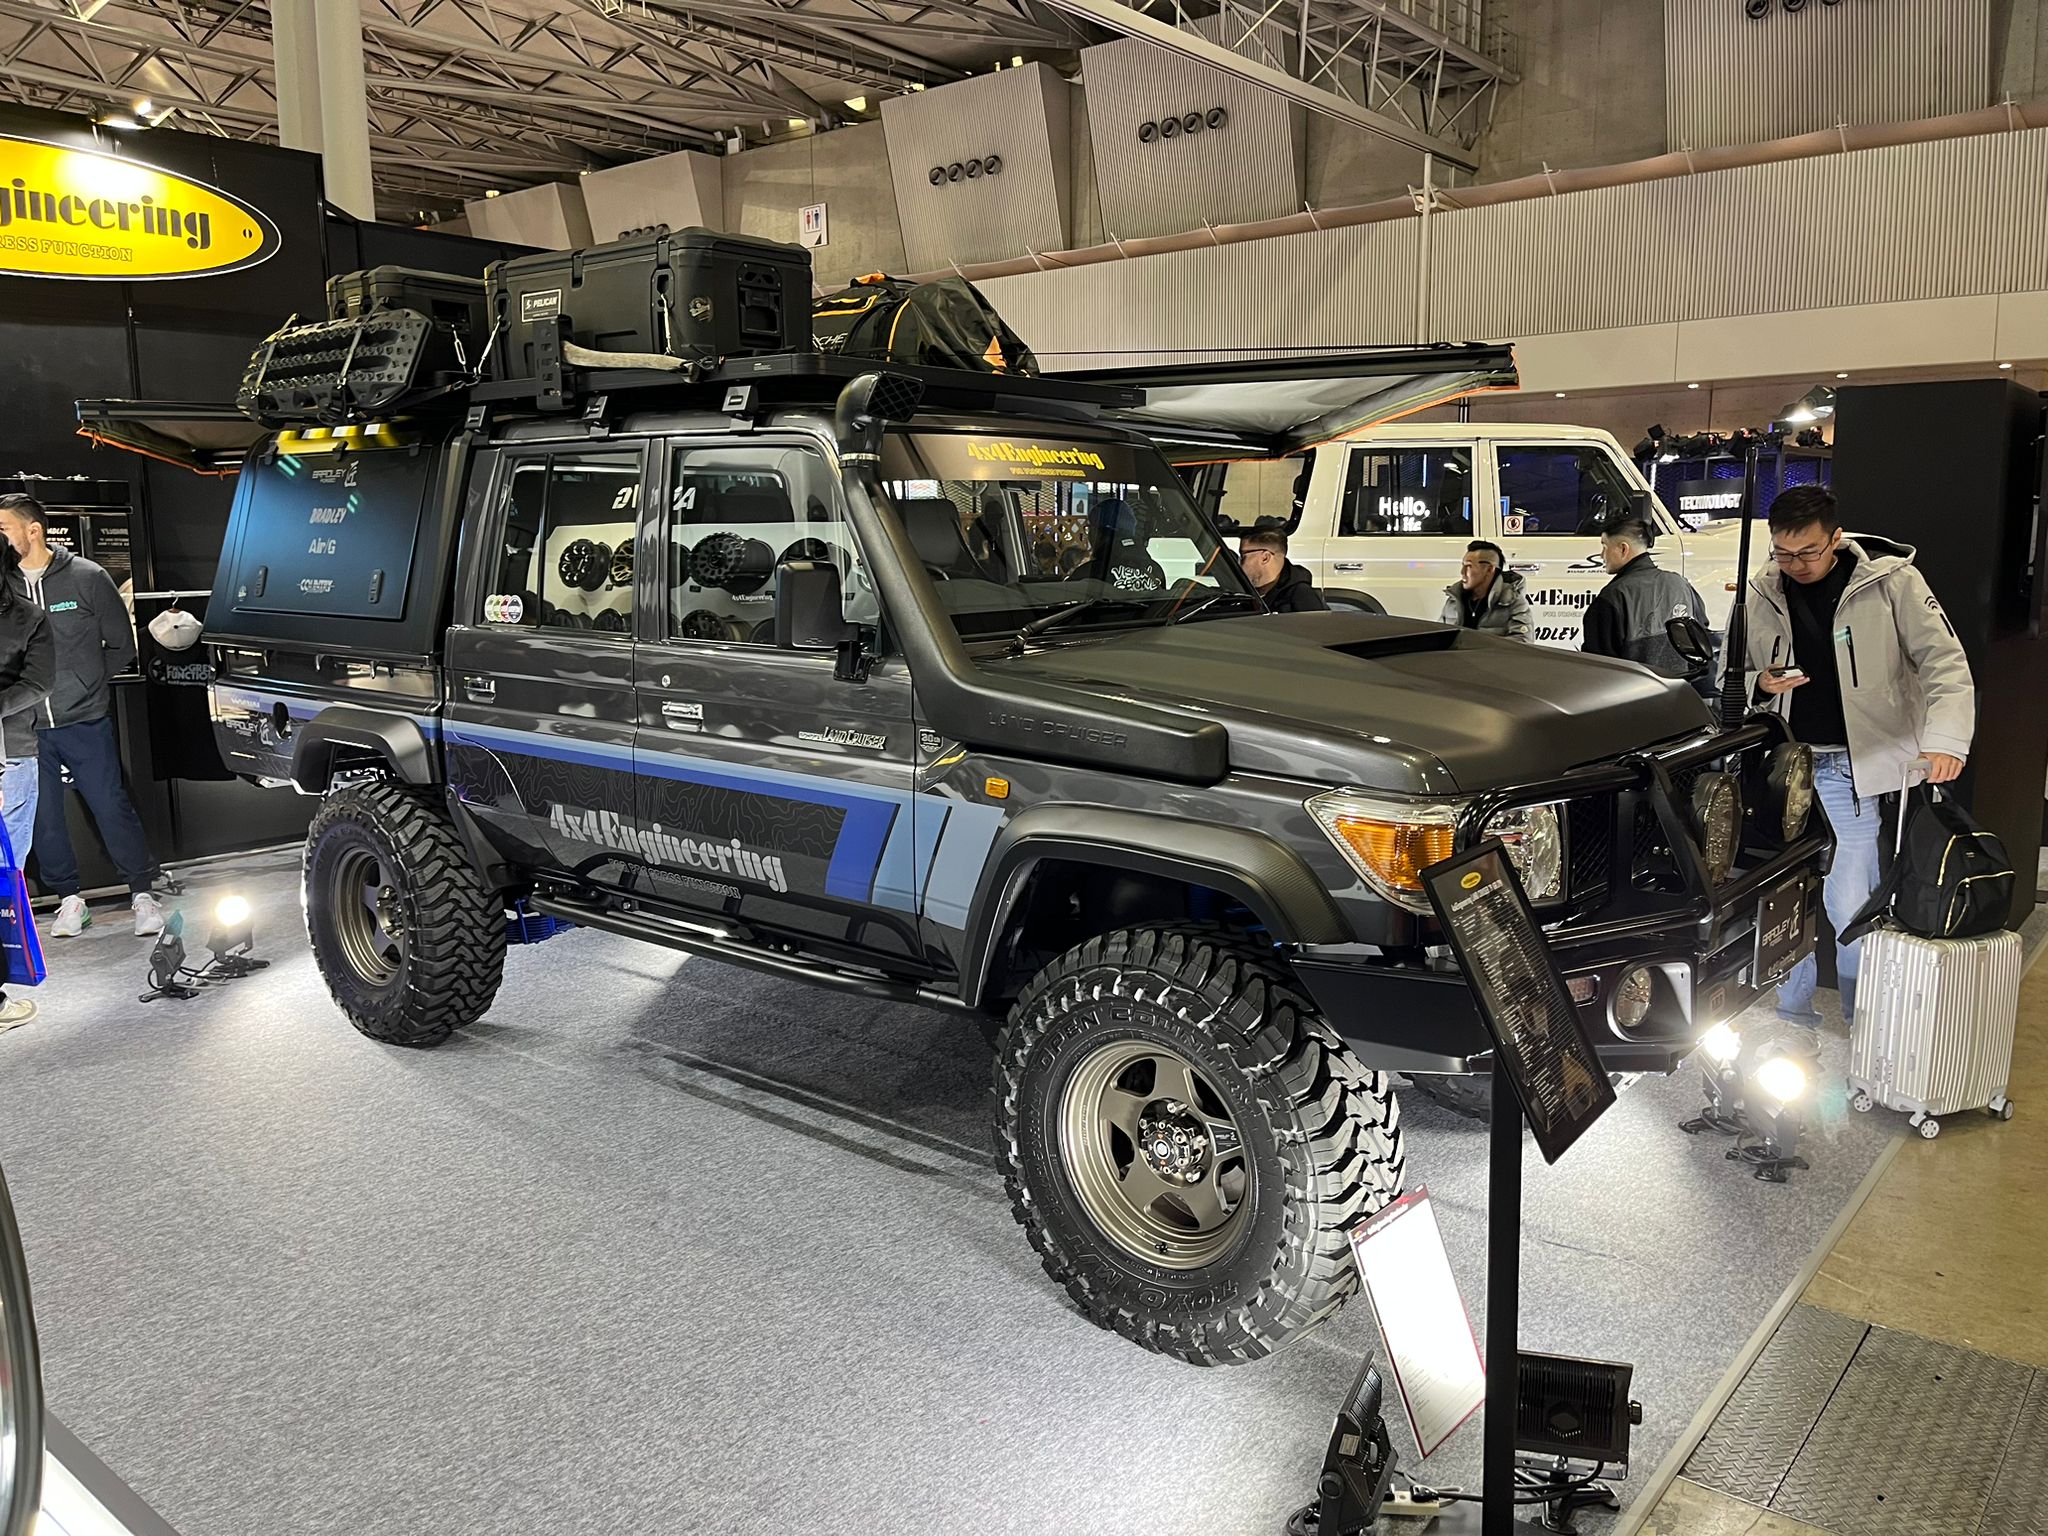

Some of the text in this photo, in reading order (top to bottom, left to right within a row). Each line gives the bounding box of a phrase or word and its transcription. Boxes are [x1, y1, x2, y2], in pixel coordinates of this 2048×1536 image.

[41, 239, 133, 262] FUNCTION
[533, 296, 558, 309] PELICAN
[967, 442, 1105, 470] 4x4Engineering
[309, 507, 347, 524] BRADLEY
[308, 537, 337, 555] Air/G
[1525, 589, 1602, 610] x4Engi
[1534, 626, 1580, 641] ADLEY
[1042, 720, 1128, 748] CRUISER
[550, 803, 788, 893] 4x4Engineering
[1761, 917, 1791, 947] BRADLEY
[1036, 1009, 1101, 1075] OPEN
